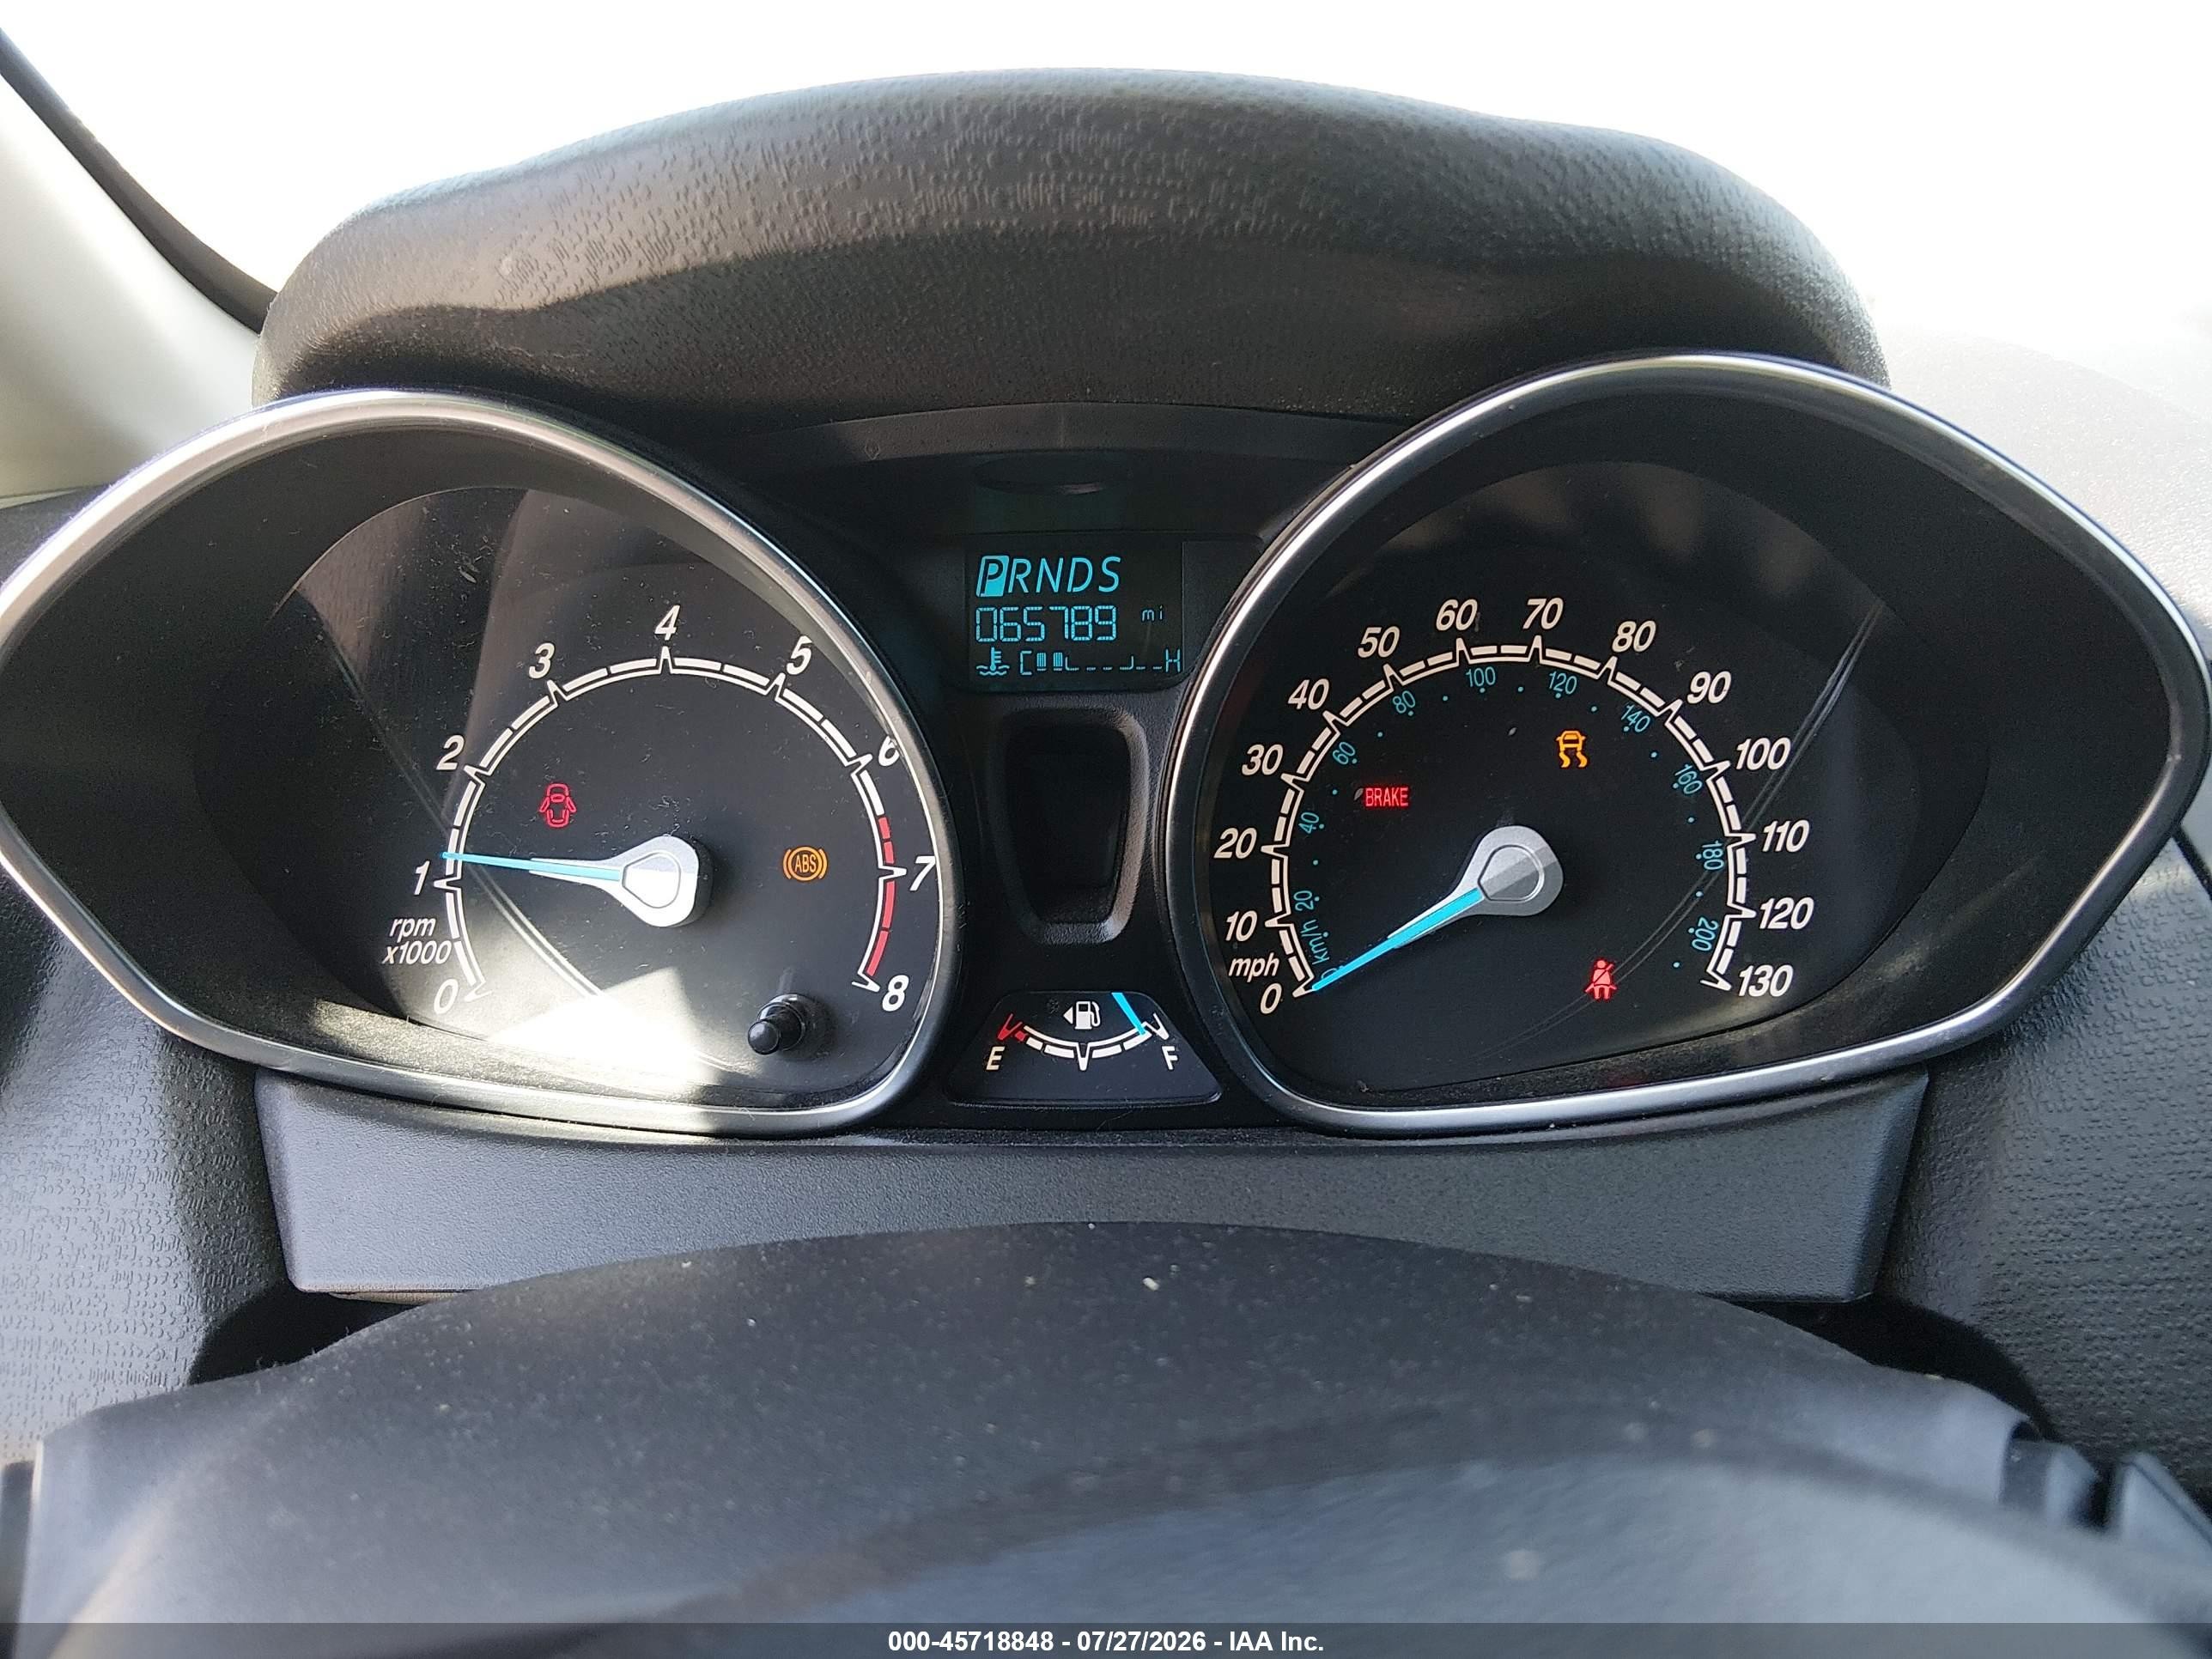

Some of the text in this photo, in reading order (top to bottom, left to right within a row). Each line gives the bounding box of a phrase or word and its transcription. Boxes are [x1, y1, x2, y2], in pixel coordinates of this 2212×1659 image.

[654, 605, 680, 640] 4
[975, 605, 1163, 642] 065789 mi
[1436, 599, 1477, 631] 60
[1522, 598, 1564, 629] 70
[1358, 627, 1400, 658] 50
[1612, 620, 1656, 653] 80
[529, 643, 555, 678] 3
[786, 636, 813, 675] 5
[1165, 649, 1180, 672] H
[1465, 667, 1496, 687] 100
[1548, 671, 1577, 695] 120
[1687, 671, 1732, 703] 90
[1288, 678, 1329, 710] 40
[1392, 690, 1416, 714] 80
[1620, 705, 1650, 733] 140
[437, 735, 465, 770] 2
[878, 736, 901, 766] 6
[1242, 744, 1284, 775] 30
[1332, 742, 1356, 765] 60
[1735, 738, 1792, 770] 100
[1675, 763, 1703, 795] 160
[1365, 787, 1408, 807] BRAKE
[1299, 811, 1320, 835] 40
[1762, 820, 1809, 852] 110
[1214, 828, 1257, 860] 20
[1701, 840, 1725, 872] 180
[413, 860, 430, 895] 1
[794, 853, 817, 874] ABS
[910, 856, 936, 890] 7
[1293, 890, 1315, 912] 20
[1759, 898, 1814, 929] 120
[390, 916, 434, 939] rpm
[1224, 911, 1258, 943] 10
[1300, 919, 1330, 965] km/h
[1691, 916, 1718, 952] 200
[382, 941, 452, 964] x1000
[1229, 953, 1280, 982] mph
[434, 979, 459, 1013] 0
[882, 975, 908, 1010] 8
[1738, 965, 1793, 997] 130
[1260, 983, 1282, 1014] 0
[986, 1047, 1005, 1070] E
[1162, 1046, 1178, 1070] F
